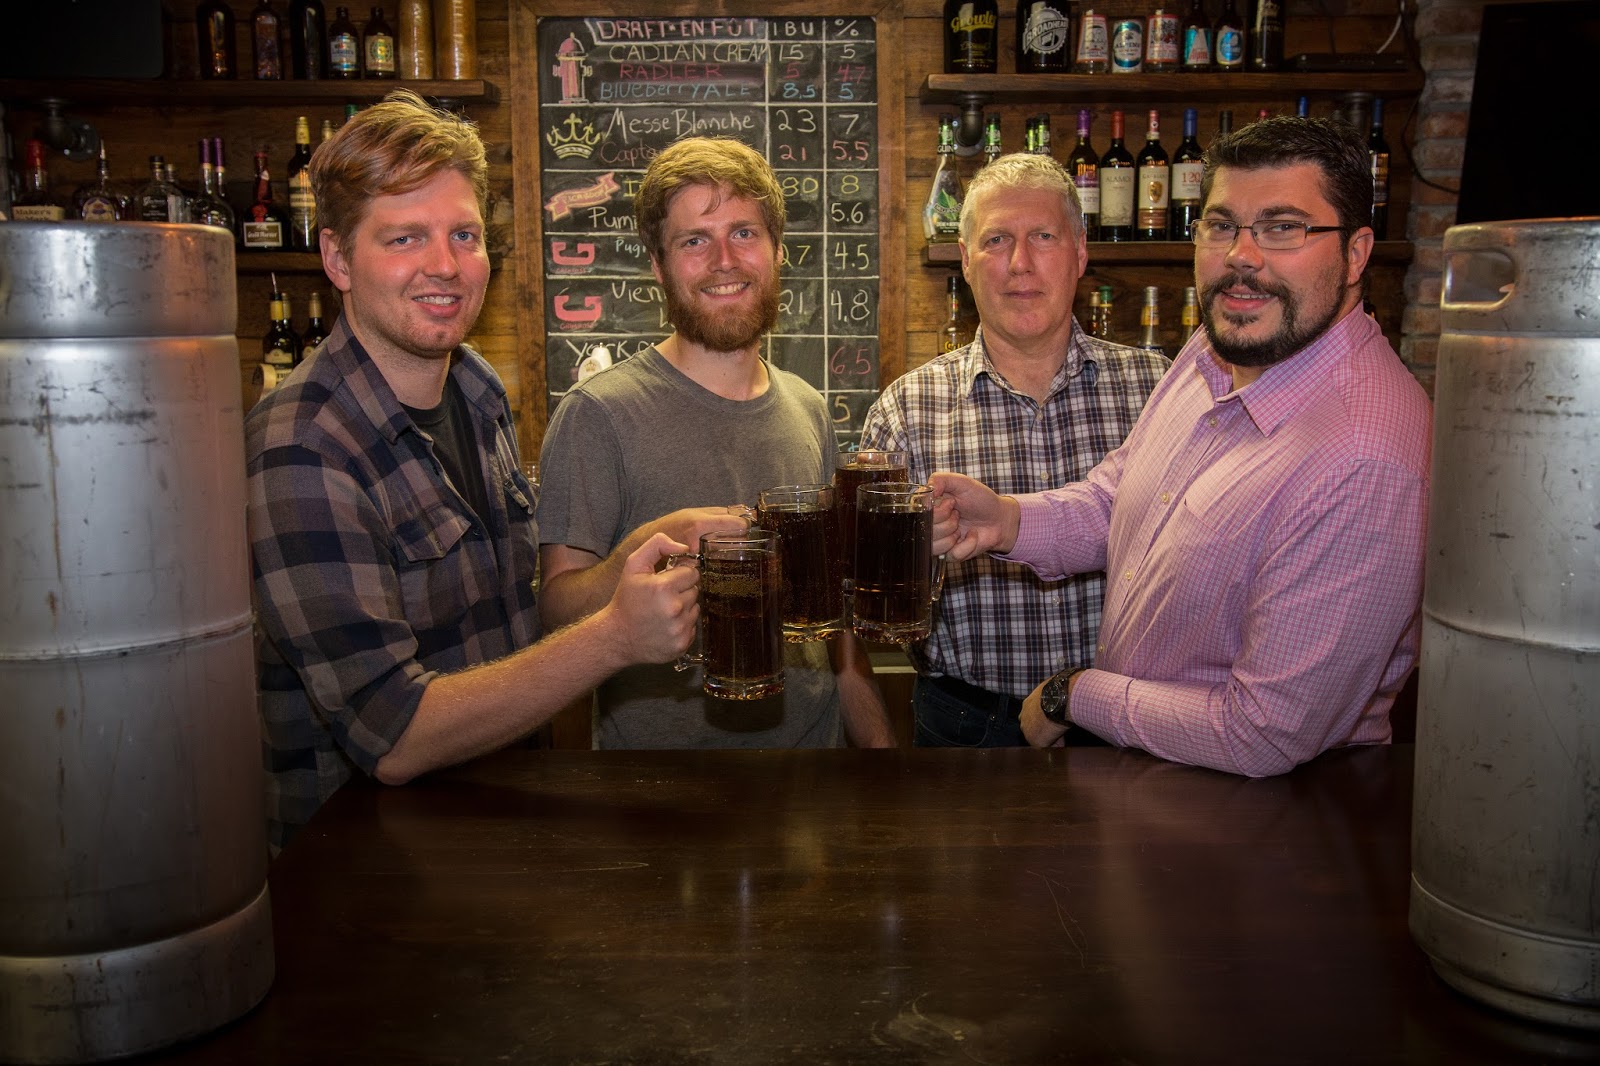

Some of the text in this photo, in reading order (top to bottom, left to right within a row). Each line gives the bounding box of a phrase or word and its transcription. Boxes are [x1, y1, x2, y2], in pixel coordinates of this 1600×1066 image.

[681, 20, 704, 37] EN
[774, 21, 814, 36] IBU
[835, 19, 859, 36] %
[609, 42, 771, 63] CADIAN CREAM
[779, 44, 804, 61] 15
[840, 43, 855, 59] 5
[620, 63, 722, 80] RADLER
[784, 62, 800, 79] 5
[837, 63, 866, 85] 4.7
[783, 82, 816, 99] 8.5
[838, 82, 854, 99] 5
[603, 107, 754, 144] Messe Blanche
[776, 109, 816, 133] 23
[838, 114, 859, 135] 7
[779, 144, 807, 161] 21
[833, 140, 870, 161] 5.5
[782, 177, 818, 197] 80
[841, 175, 859, 194] 8
[1181, 172, 1200, 184] 120
[831, 202, 864, 224] 5.6
[781, 243, 811, 269] 27
[834, 241, 869, 270] 4.5
[612, 281, 667, 302] Vien
[830, 289, 870, 322] 4.8
[831, 346, 871, 375] 6.5
[833, 395, 851, 423] 5
